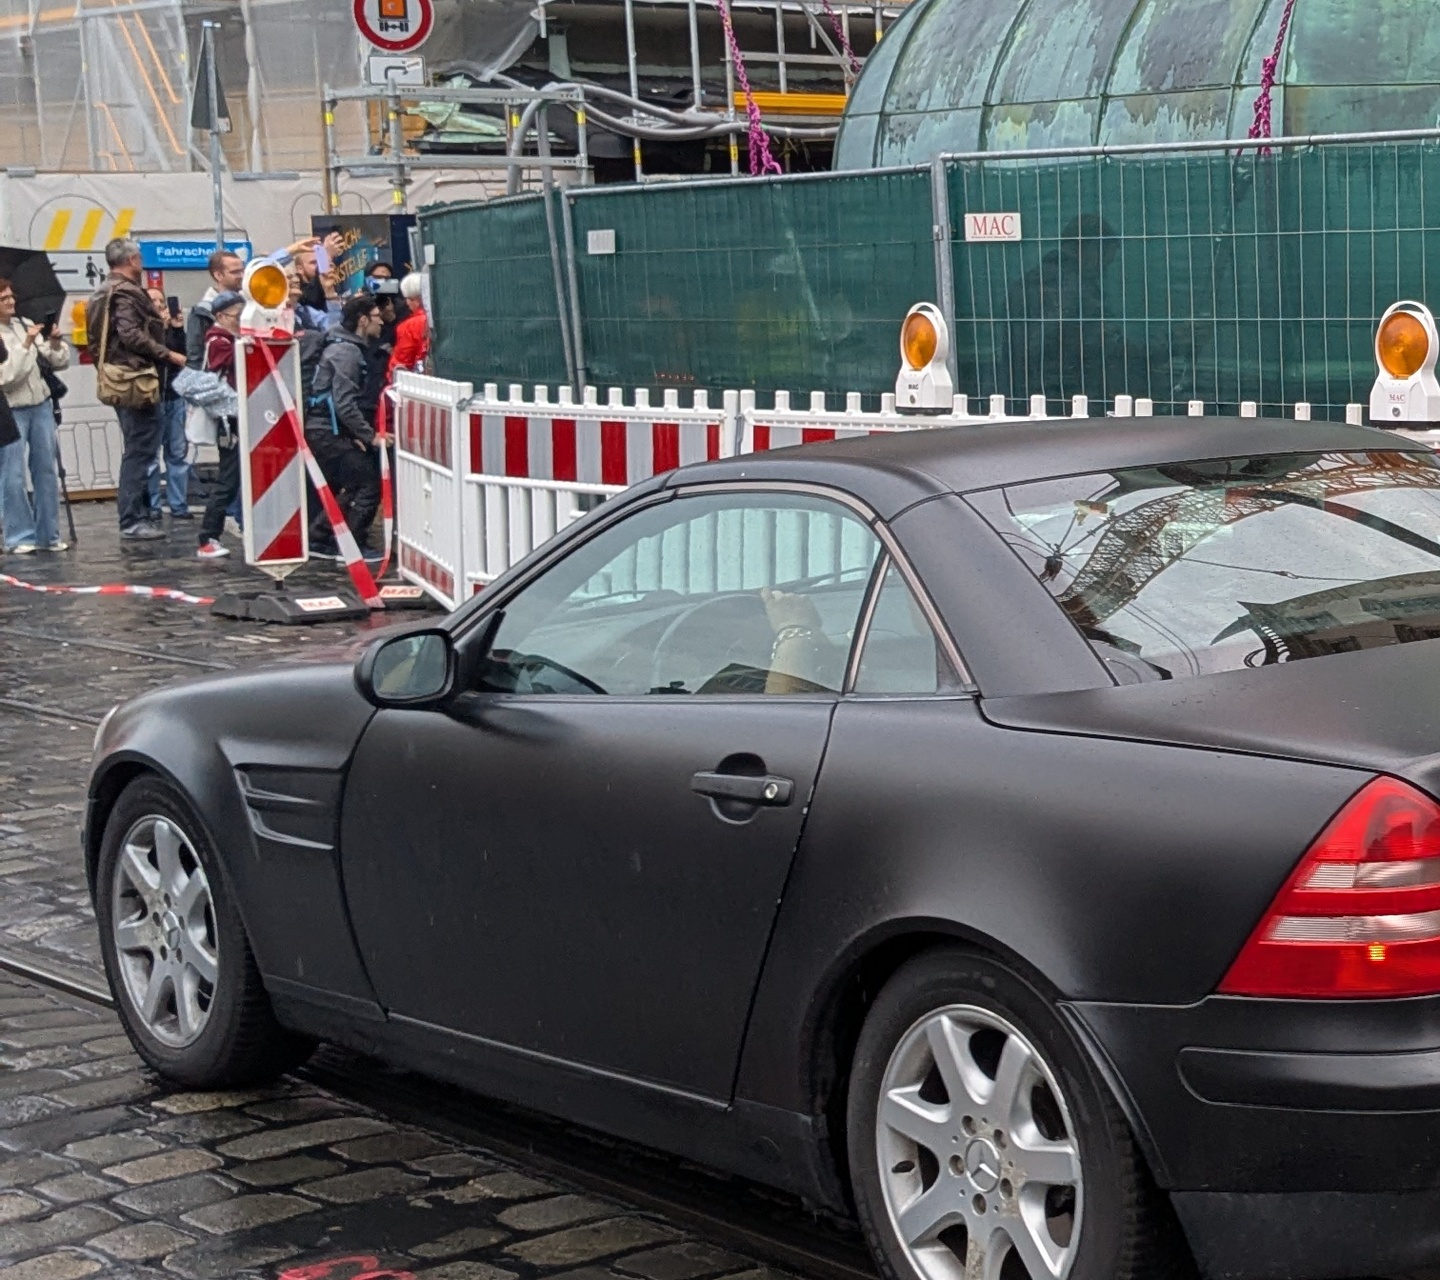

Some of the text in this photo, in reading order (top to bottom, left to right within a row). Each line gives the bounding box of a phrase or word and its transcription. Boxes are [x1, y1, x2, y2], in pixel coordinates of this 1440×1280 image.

[972, 215, 1014, 236] MAC
[1389, 393, 1406, 402] MAC
[382, 588, 420, 596] MAC
